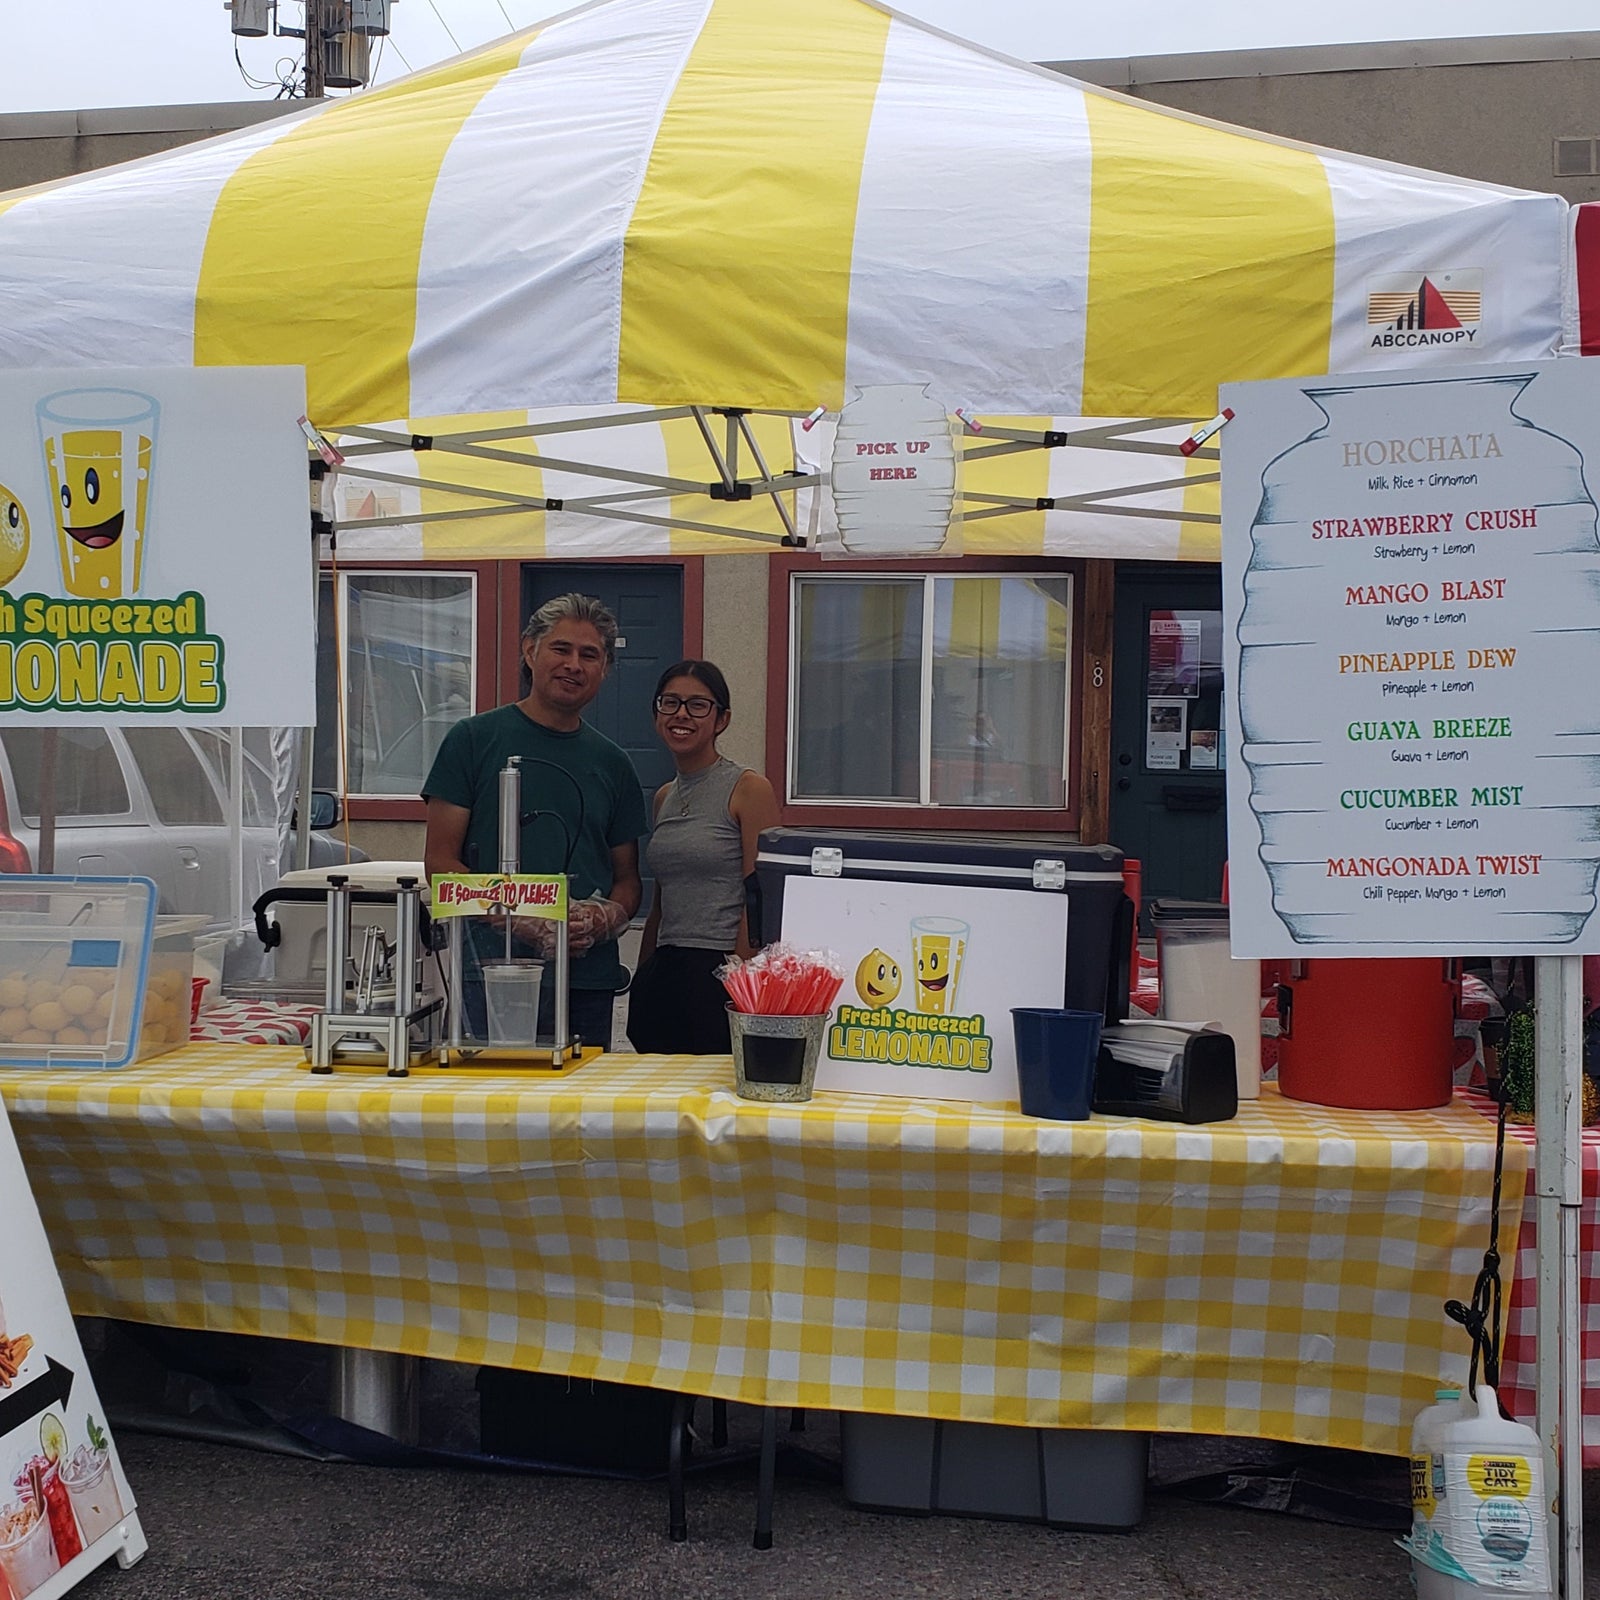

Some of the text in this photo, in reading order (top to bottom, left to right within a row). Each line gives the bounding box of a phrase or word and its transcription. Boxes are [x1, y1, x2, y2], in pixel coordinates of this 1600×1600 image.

[1371, 329, 1477, 347] ABCCANOPY
[856, 441, 931, 456] PICK UP
[1342, 433, 1504, 467] HORCHATA
[870, 467, 918, 481] HERE
[1393, 475, 1414, 490] Rice
[1418, 478, 1425, 486] +
[1429, 473, 1478, 488] Cinnamon
[1311, 509, 1538, 540] STRAWBERRY CRUSH
[1374, 542, 1476, 562] Strawberry + Lemon
[1345, 578, 1507, 606] MANGO BLAST
[23, 596, 197, 640] Squeezed
[1386, 612, 1467, 629] Mango + Lemon
[1338, 647, 1517, 674] PINEAPPLE DEW
[1093, 667, 1104, 688] 8
[1431, 683, 1438, 691] +
[1441, 680, 1474, 693] Lemon
[1348, 717, 1513, 741] GUAVA BREEZE
[1391, 748, 1469, 763] Guava + Lemon
[1340, 785, 1524, 809] CUCUMBER MIST
[1385, 817, 1432, 831] Cucumber
[1446, 816, 1479, 831] Lemon
[1326, 854, 1543, 878] MANGONADA TWIST
[438, 881, 559, 905] WE SQUEEZE TO PLEASE!
[1363, 886, 1383, 899] Chili
[1425, 886, 1458, 901] Mango
[1474, 886, 1506, 899] Lemon
[841, 1007, 982, 1035] Fresh Squeezed
[831, 1027, 990, 1070] LEMONADE
[1483, 1478, 1518, 1488] CATS
[1484, 1468, 1516, 1478] TIDY
